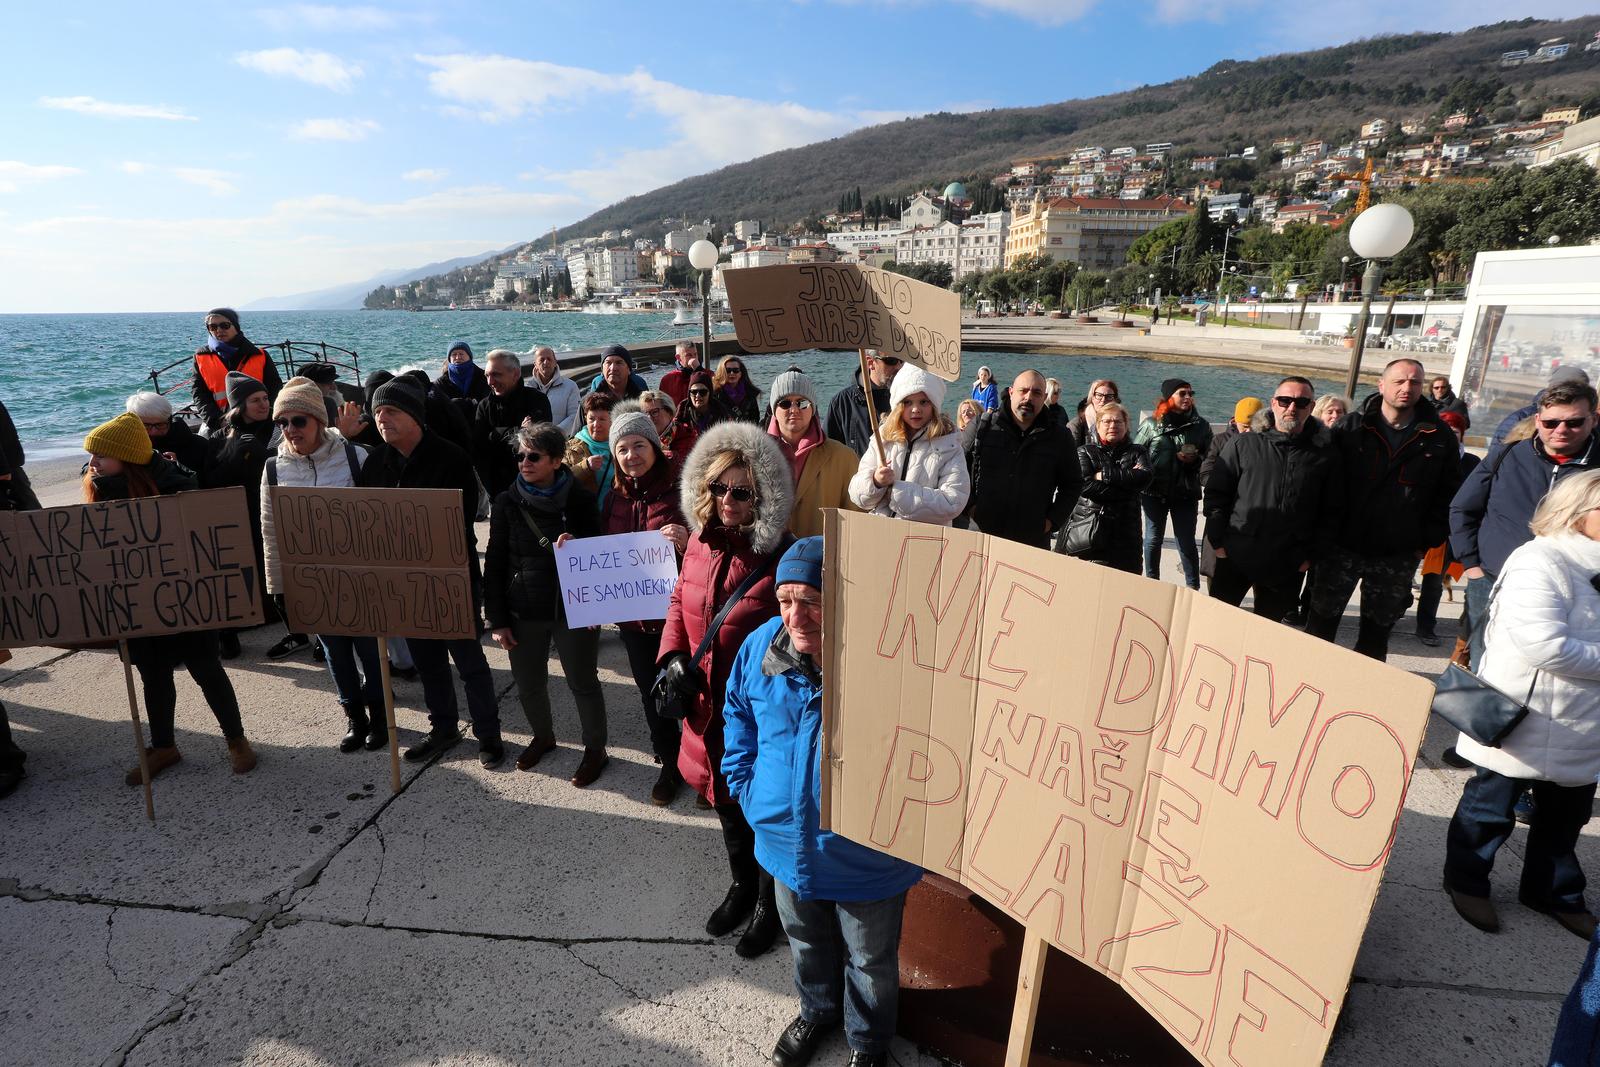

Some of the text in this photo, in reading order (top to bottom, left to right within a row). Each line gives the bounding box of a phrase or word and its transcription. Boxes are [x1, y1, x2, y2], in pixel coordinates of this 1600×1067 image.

[799, 266, 912, 315] JAVNO
[740, 301, 961, 374] JE NAŠE DOBRO
[0, 525, 240, 592] MATER HOTE, NE
[28, 500, 162, 554] VRAŽJU
[445, 506, 468, 565] U
[569, 545, 676, 573] PLAŽE SVIMA
[0, 566, 257, 642] AMO NAŠE GROTE!
[567, 586, 590, 605] NE
[594, 582, 634, 602] SAMO
[877, 535, 1411, 871] NE DAMO
[982, 700, 1202, 872] NAŠE
